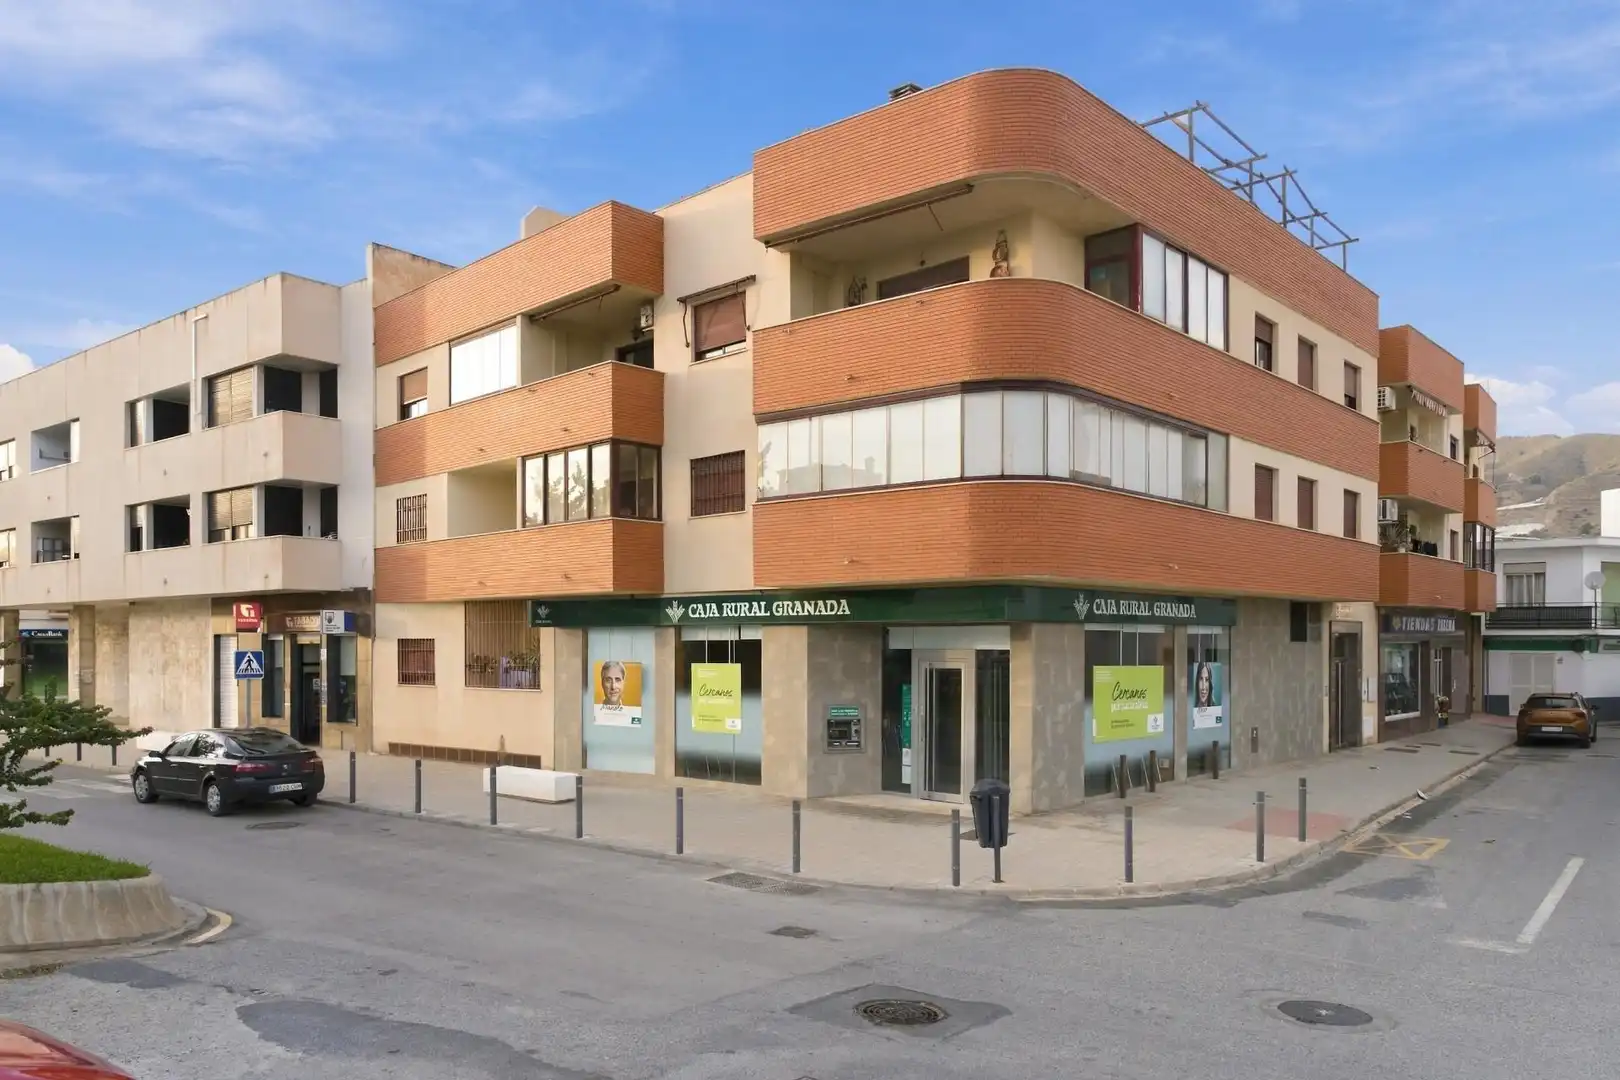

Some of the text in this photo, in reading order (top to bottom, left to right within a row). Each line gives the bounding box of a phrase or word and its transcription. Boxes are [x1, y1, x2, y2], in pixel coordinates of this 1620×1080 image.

[688, 599, 851, 618] CAJA RURAL GRANADA
[1093, 598, 1197, 618] CAJA RURAL GRANADA
[1402, 617, 1436, 631] TIENDAS
[1111, 681, 1149, 702] Cercanos
